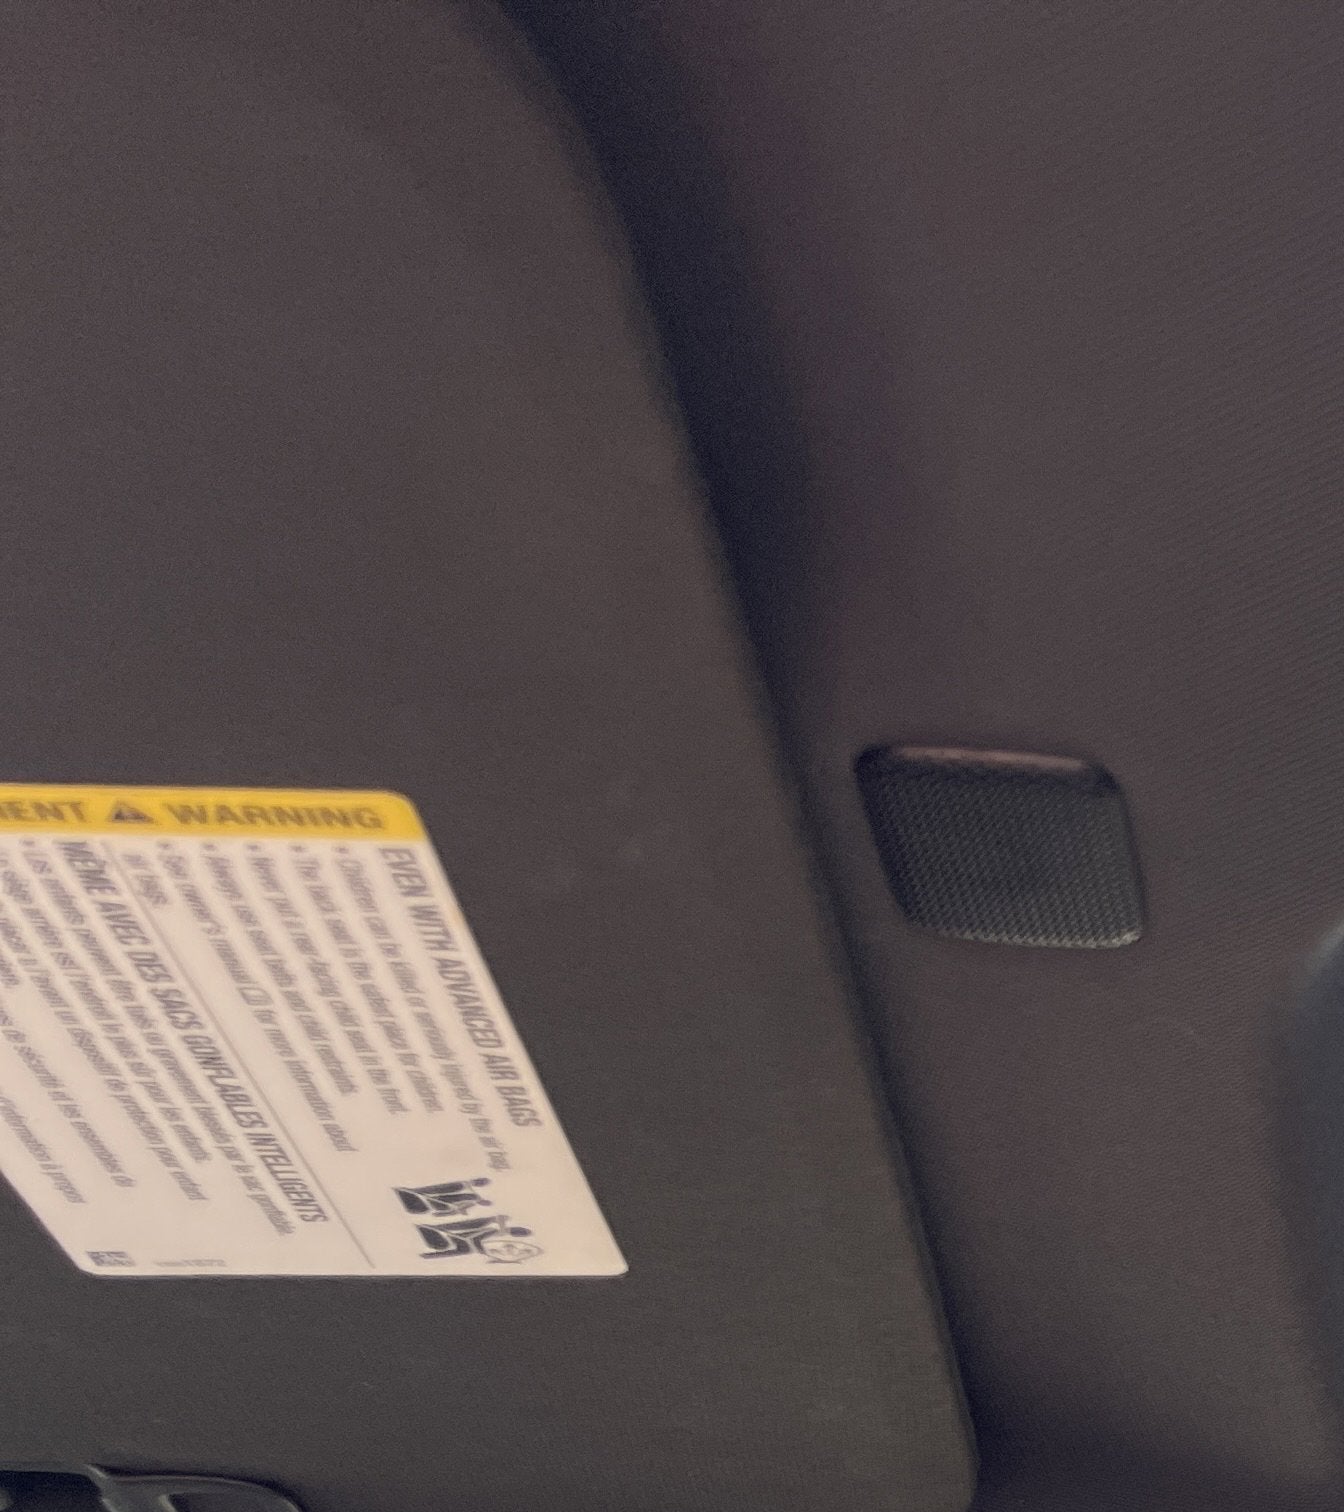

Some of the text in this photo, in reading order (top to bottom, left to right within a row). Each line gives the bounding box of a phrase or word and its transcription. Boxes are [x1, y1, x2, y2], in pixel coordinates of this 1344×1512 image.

[163, 803, 384, 830] WARNING
[93, 902, 152, 944] AVEC
[126, 951, 174, 982] DES
[149, 988, 205, 1029] SACS
[209, 939, 256, 984] manual
[263, 1029, 296, 1056] more
[282, 1060, 337, 1120] information
[377, 847, 542, 1126] EVEN WITH ADVANCED AIR BAGS
[178, 1035, 269, 1128] GONFLABLES
[409, 1011, 457, 1060] seriously
[436, 1063, 477, 1100] injured
[244, 1133, 330, 1222] INTELLIGENTS
